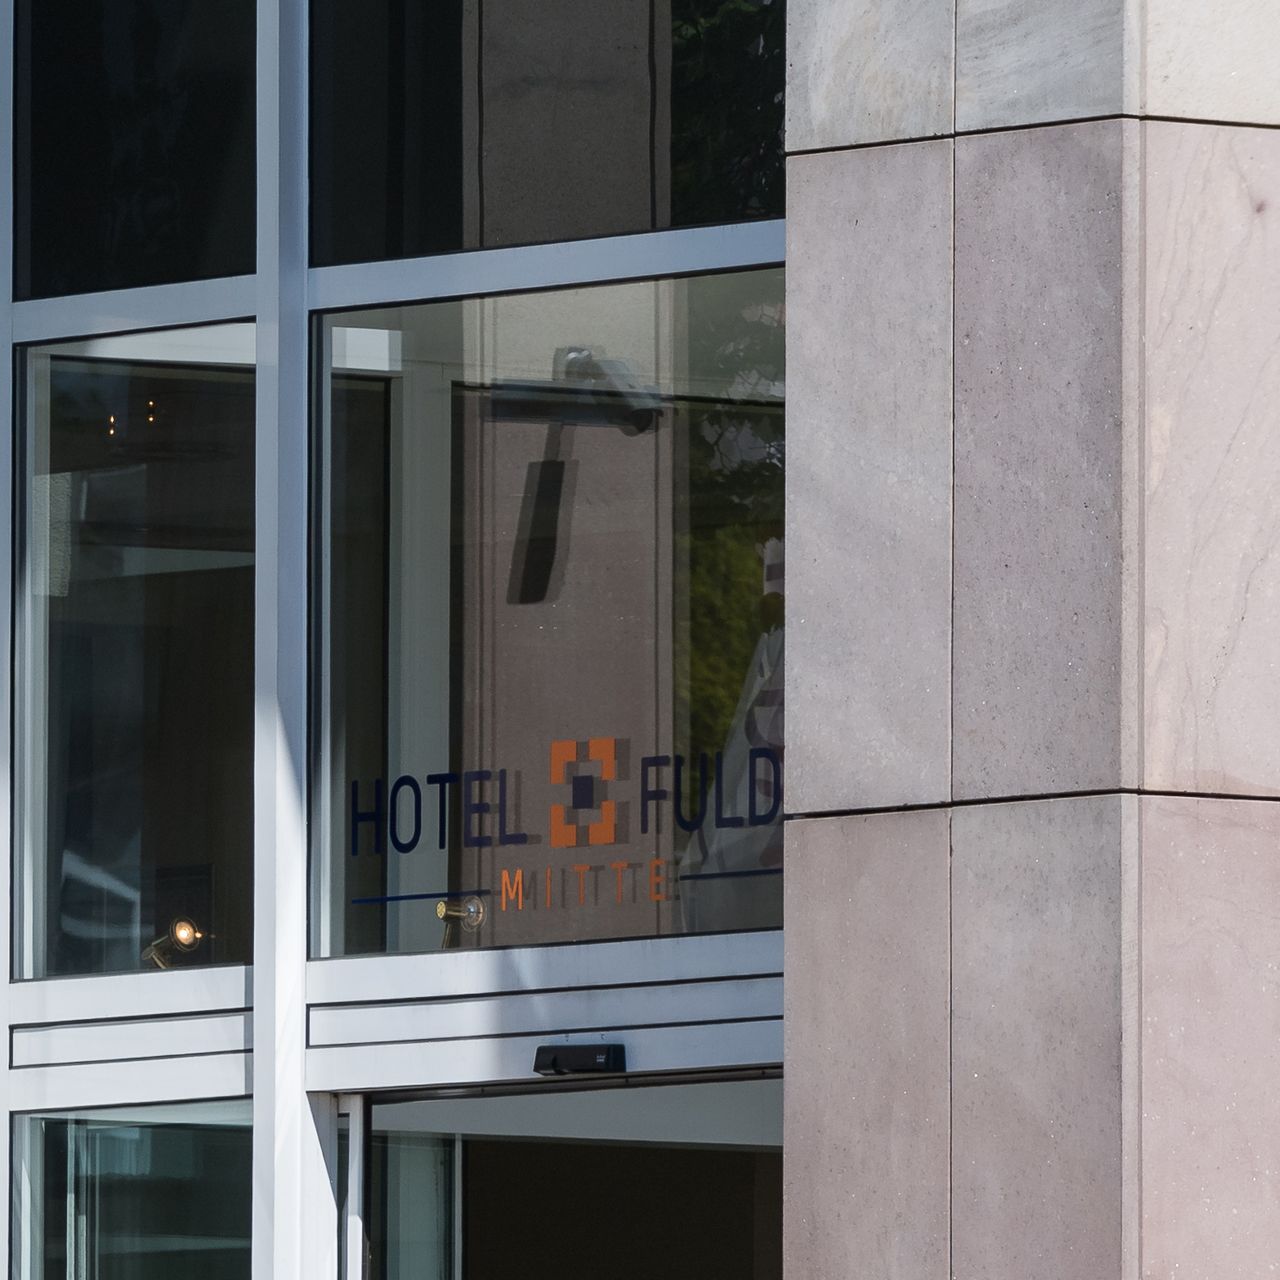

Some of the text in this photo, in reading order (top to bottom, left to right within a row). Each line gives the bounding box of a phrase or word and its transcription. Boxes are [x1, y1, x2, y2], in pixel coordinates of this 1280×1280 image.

[350, 747, 782, 856] HOTEL FULD
[500, 858, 669, 912] MITTE
